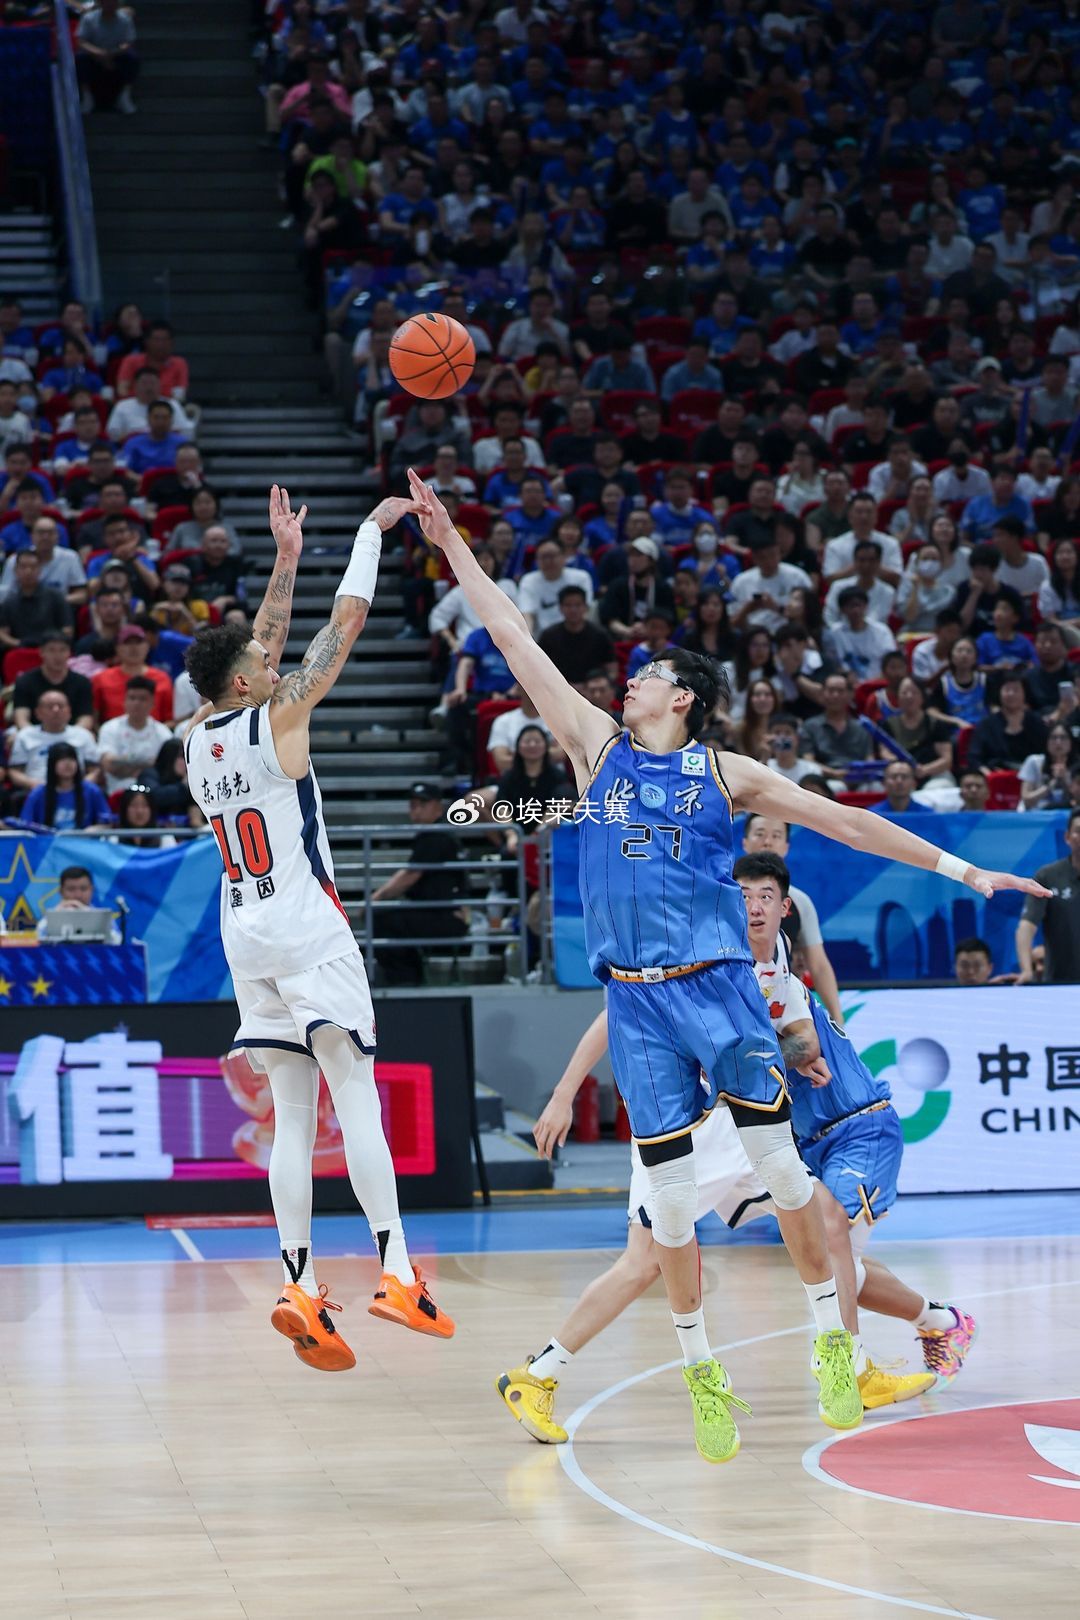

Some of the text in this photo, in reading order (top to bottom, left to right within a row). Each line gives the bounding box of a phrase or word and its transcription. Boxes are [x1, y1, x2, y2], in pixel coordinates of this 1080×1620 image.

[210, 808, 273, 883] 10
[621, 823, 682, 861] 27
[10, 1032, 173, 1185] 值
